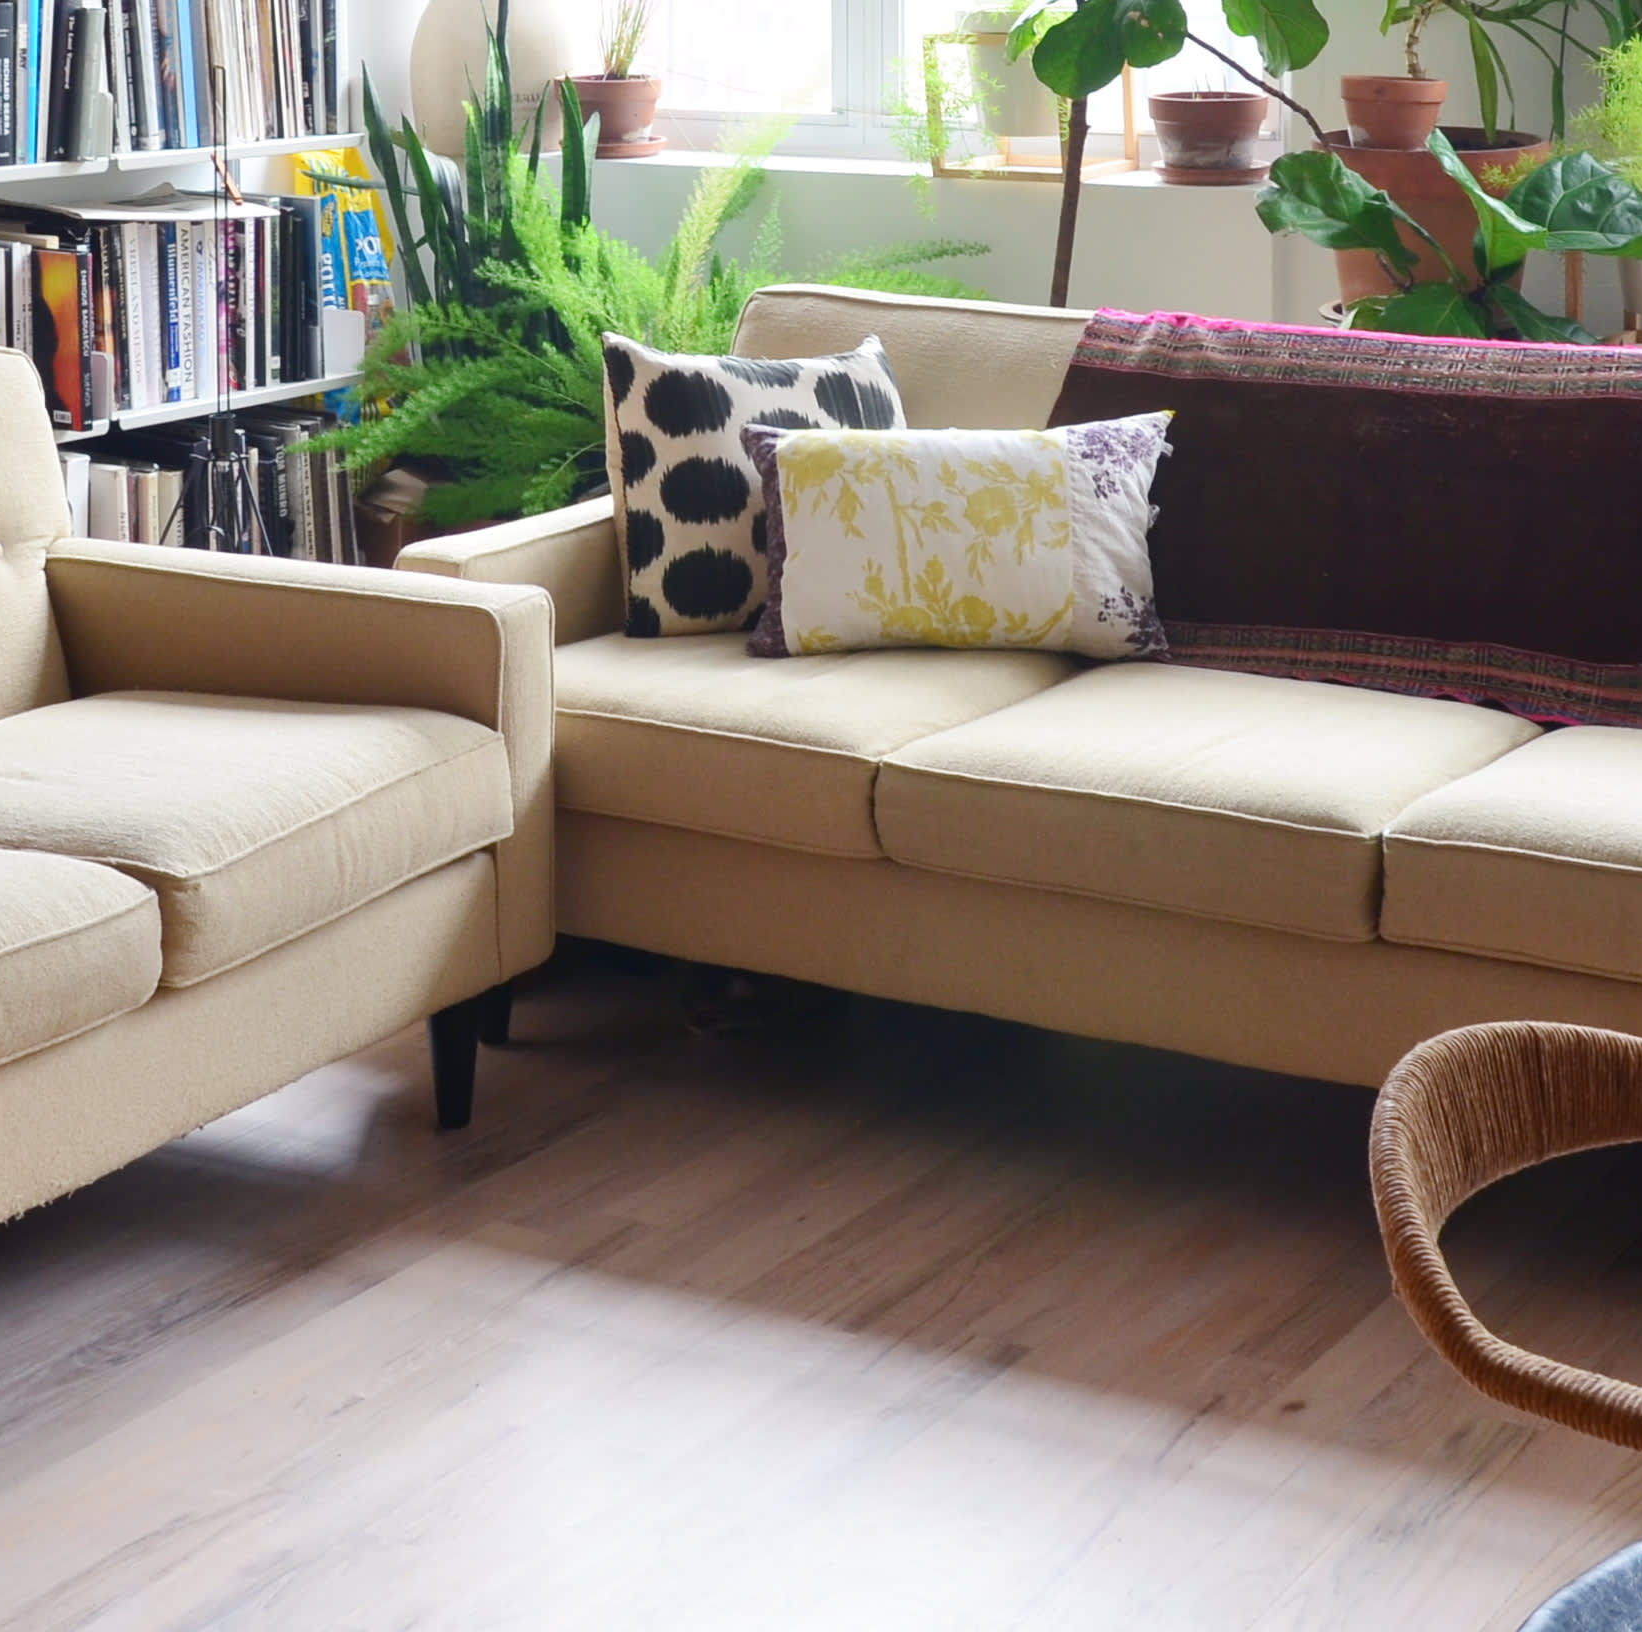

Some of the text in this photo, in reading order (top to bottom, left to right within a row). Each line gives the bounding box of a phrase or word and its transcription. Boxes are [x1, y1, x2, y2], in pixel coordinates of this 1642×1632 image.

[167, 243, 180, 323] Blumenfeld
[179, 228, 194, 383] AMERICAN FASHION
